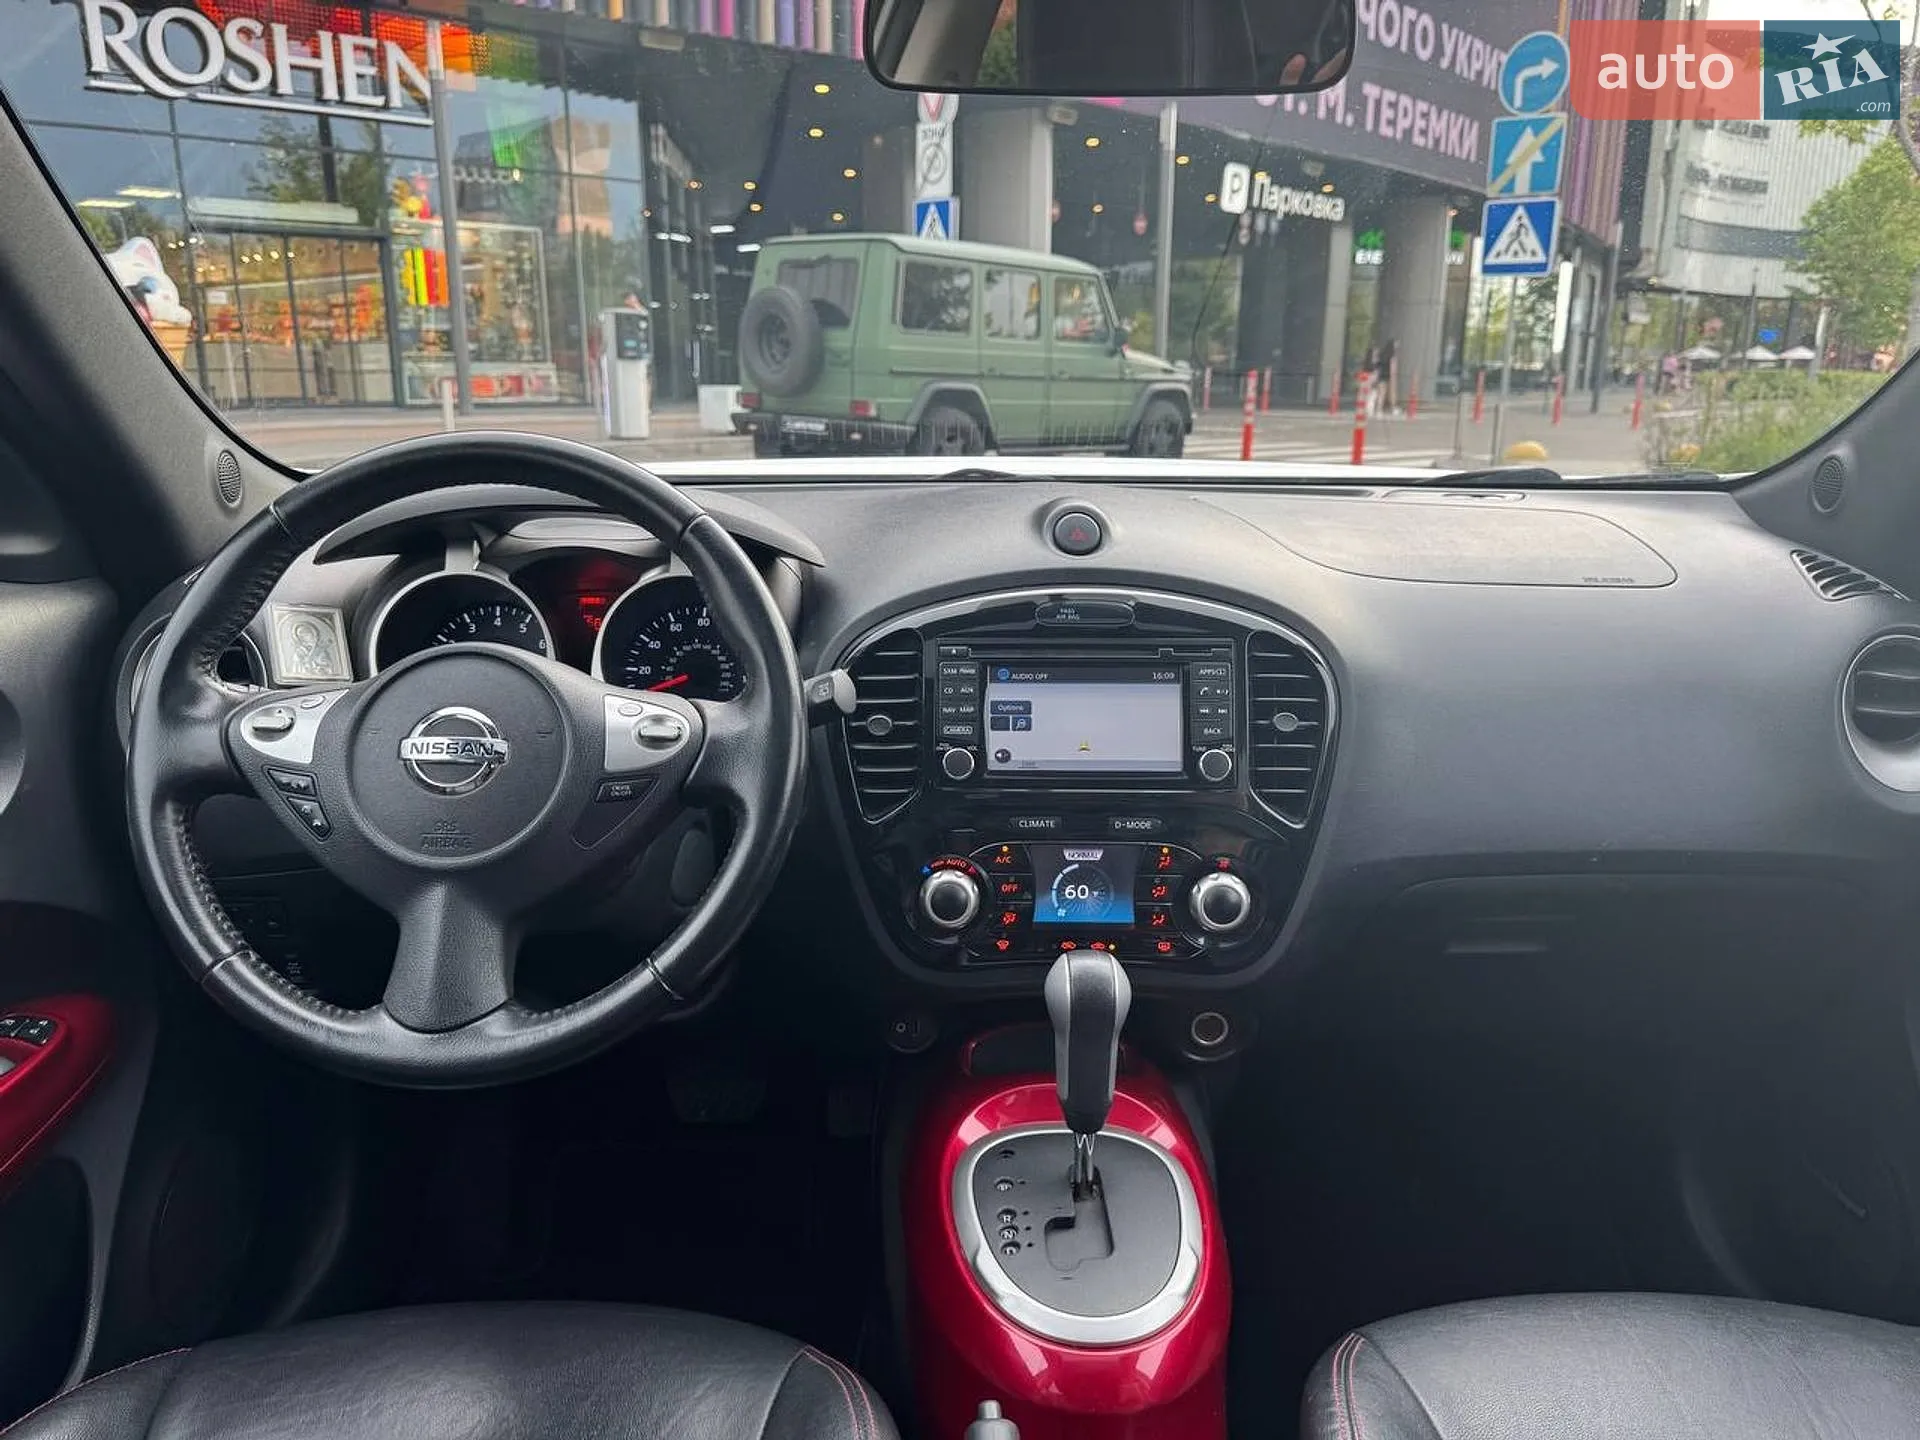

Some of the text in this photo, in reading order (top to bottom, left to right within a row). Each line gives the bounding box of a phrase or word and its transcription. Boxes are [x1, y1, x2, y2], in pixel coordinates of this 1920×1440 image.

[82, 0, 433, 112] ROSHEN
[1362, 81, 1480, 162] ТЕРЕМКИ
[1253, 176, 1345, 222] Парковка
[493, 617, 501, 626] 4
[697, 618, 710, 627] 80
[468, 623, 476, 633] 3
[519, 623, 527, 633] 5
[669, 623, 682, 632] 60
[648, 641, 661, 649] 40
[638, 666, 651, 675] 20
[409, 741, 494, 757] NISSAN
[1018, 820, 1056, 829] CLIMATE
[1114, 821, 1152, 830] D-MODE
[995, 856, 1012, 864] A/C
[1001, 884, 1018, 892] OFF
[1065, 885, 1089, 899] 60
